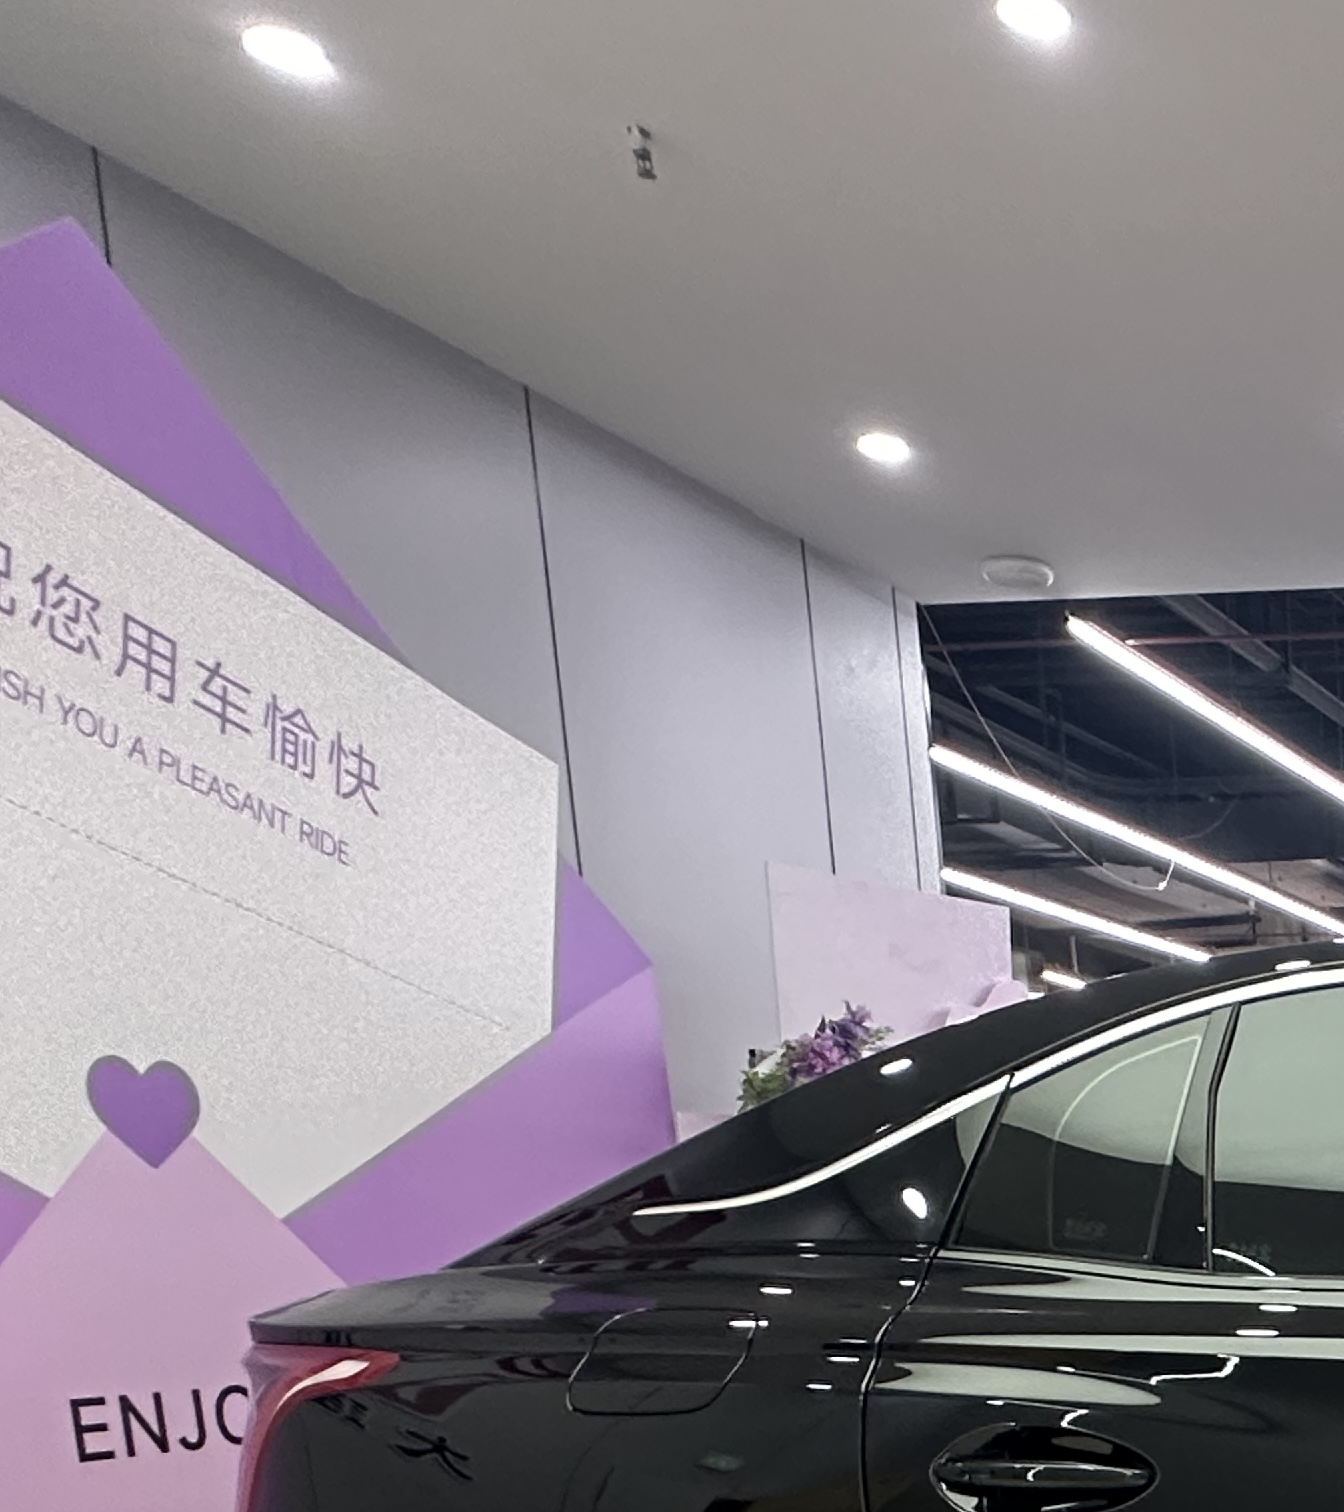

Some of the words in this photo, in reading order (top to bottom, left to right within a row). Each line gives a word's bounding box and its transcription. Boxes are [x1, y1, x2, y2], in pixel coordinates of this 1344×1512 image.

[55, 694, 119, 749] YOU
[127, 736, 148, 766] A
[157, 747, 292, 834] PLEASANT
[300, 817, 354, 868] RIDE
